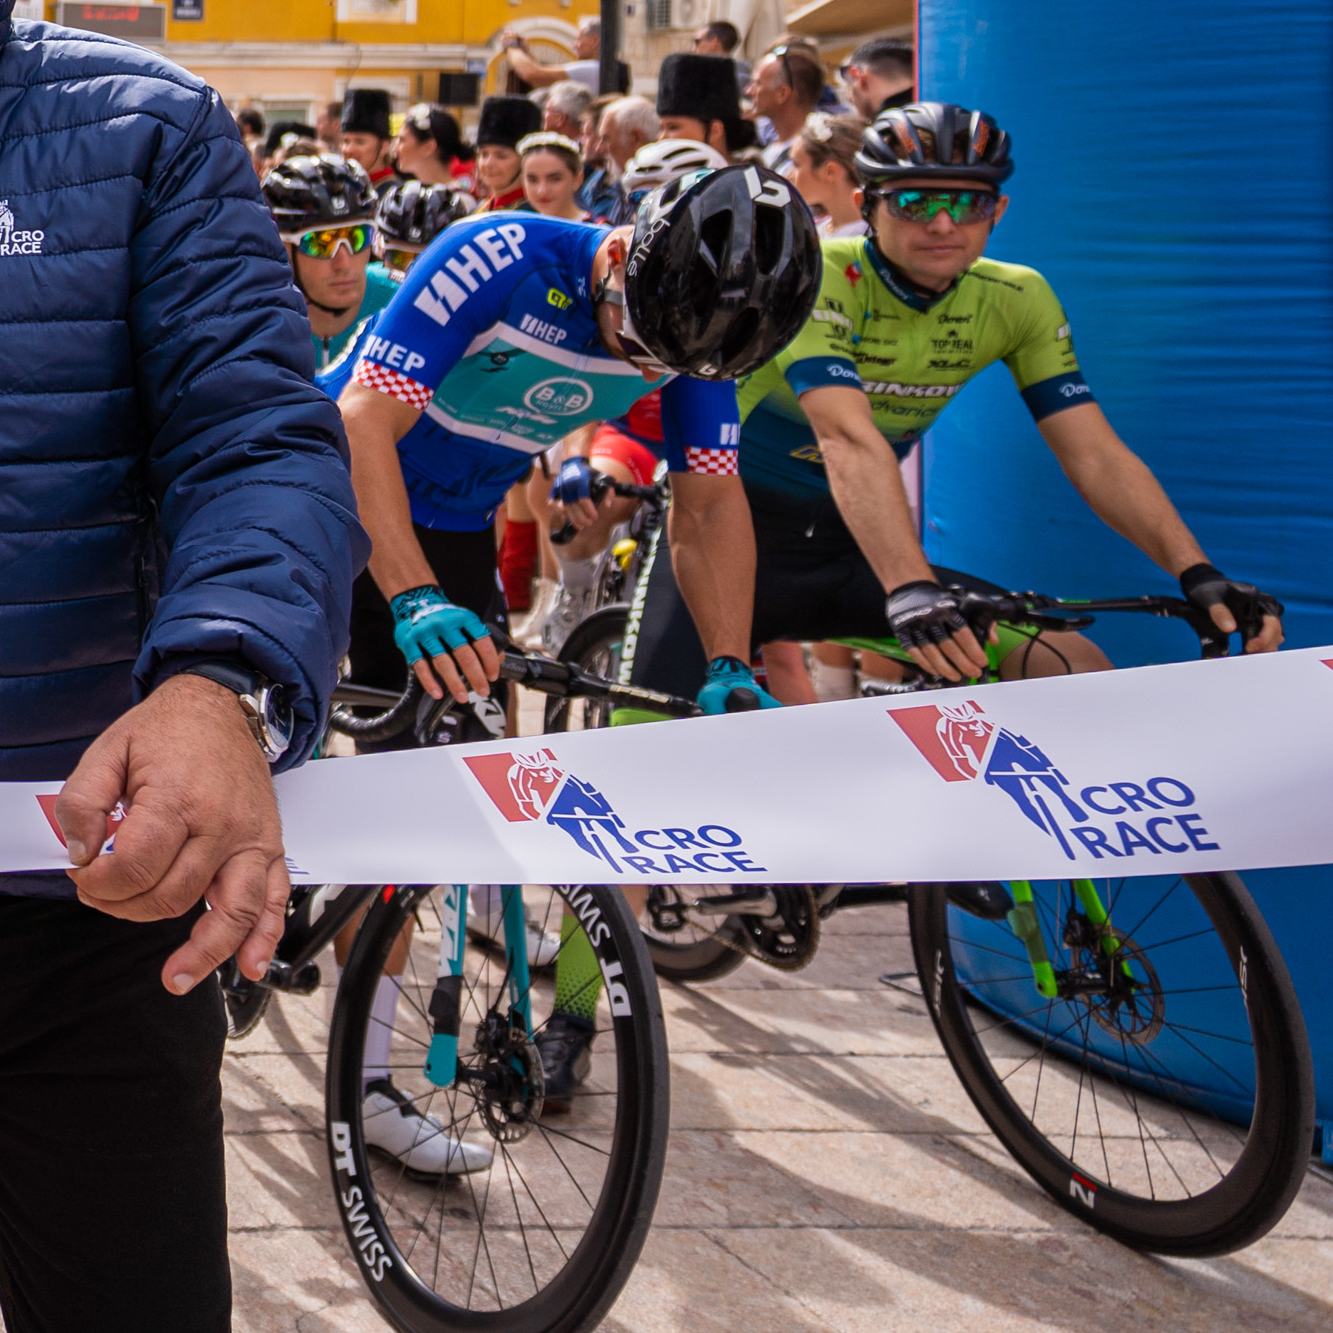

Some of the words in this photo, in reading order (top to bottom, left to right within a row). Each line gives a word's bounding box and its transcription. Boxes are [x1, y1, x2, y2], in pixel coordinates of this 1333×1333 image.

[0, 241, 42, 256] RACE
[11, 230, 45, 242] CRO
[445, 223, 526, 293] HEP
[534, 319, 567, 345] HEP
[370, 336, 426, 373] HEP
[1079, 776, 1197, 816] CRO
[633, 824, 743, 850] CRO
[1069, 813, 1221, 859] RACE
[620, 851, 769, 875] RACE
[600, 956, 632, 1017] DT
[331, 1121, 357, 1176] DT
[341, 1185, 393, 1283] SWISS
